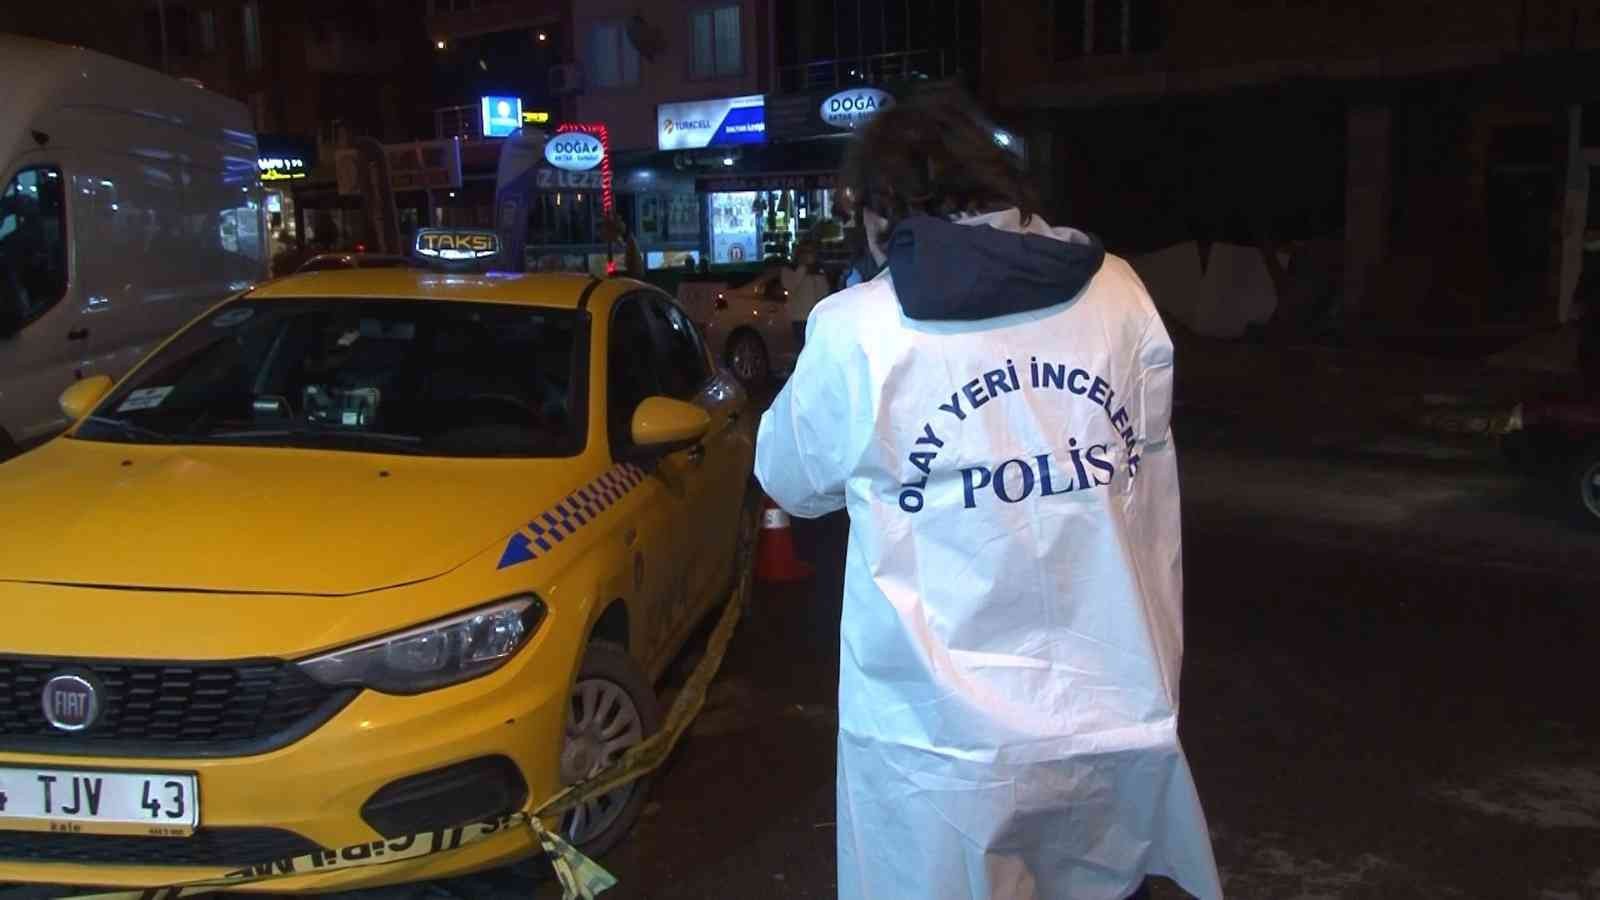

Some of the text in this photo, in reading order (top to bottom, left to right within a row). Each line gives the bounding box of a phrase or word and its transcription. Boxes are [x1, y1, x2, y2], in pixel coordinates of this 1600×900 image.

[898, 423, 944, 514] OLAY
[939, 359, 1020, 421] YERİ
[960, 437, 1115, 509] POLİS
[55, 691, 86, 719] FIAT
[37, 775, 102, 815] TJV
[141, 780, 185, 819] 43
